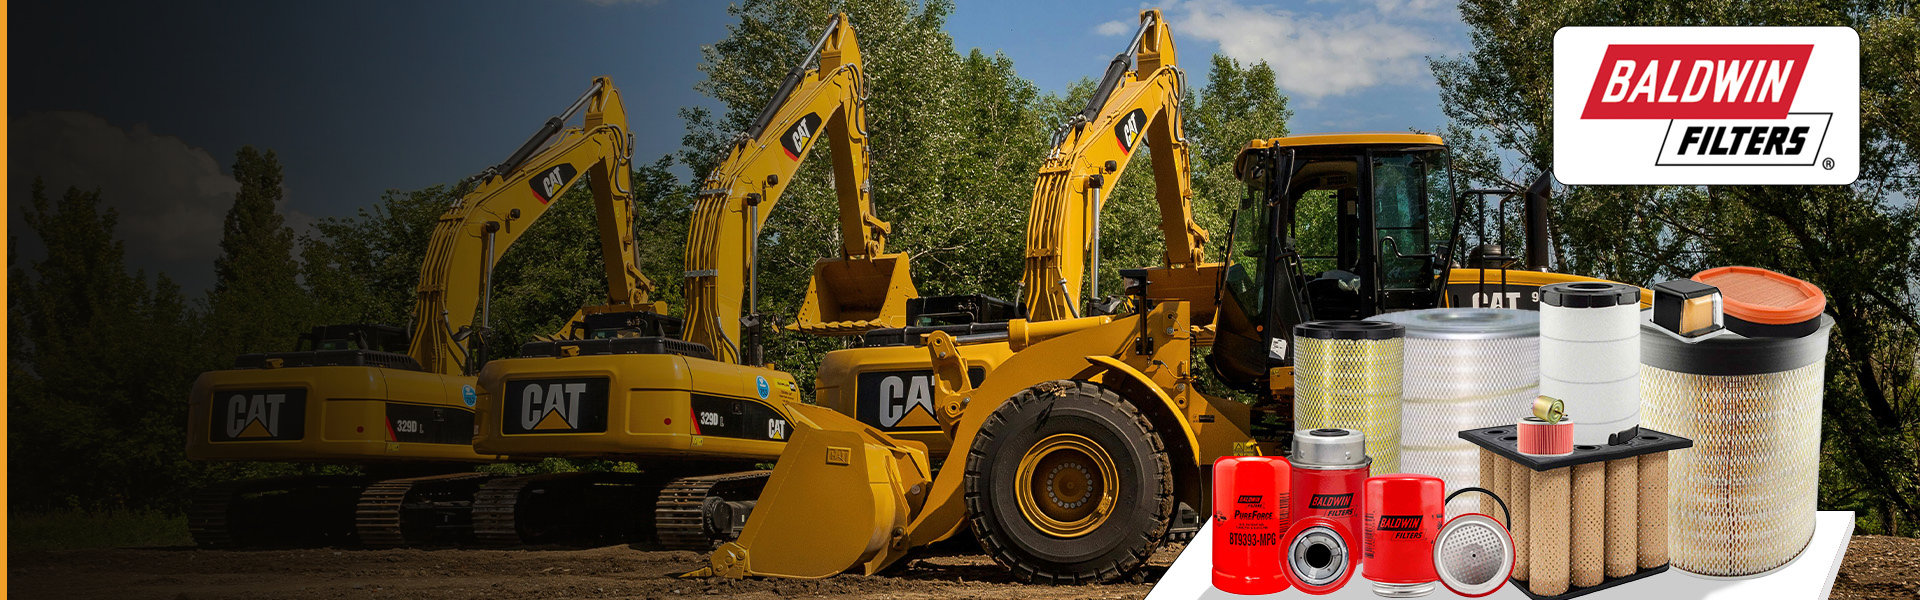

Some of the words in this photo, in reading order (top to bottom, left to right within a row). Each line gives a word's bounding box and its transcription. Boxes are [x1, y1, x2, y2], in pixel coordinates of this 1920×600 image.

[792, 117, 811, 153] CAT
[1123, 112, 1138, 148] CAT
[543, 166, 563, 198] CAT
[521, 383, 587, 430] CAT
[879, 375, 935, 428] CA
[226, 393, 286, 438] CAT
[700, 411, 719, 426] 329D
[396, 419, 418, 433] 329D
[768, 418, 786, 440] CAT
[829, 449, 849, 463] CAT
[1312, 495, 1351, 507] BALDWIN
[1327, 508, 1354, 517] FILTERS
[1379, 517, 1420, 529] BALDWIN
[1229, 532, 1276, 546] BT9393-MPG
[1395, 532, 1423, 540] FILTERS
